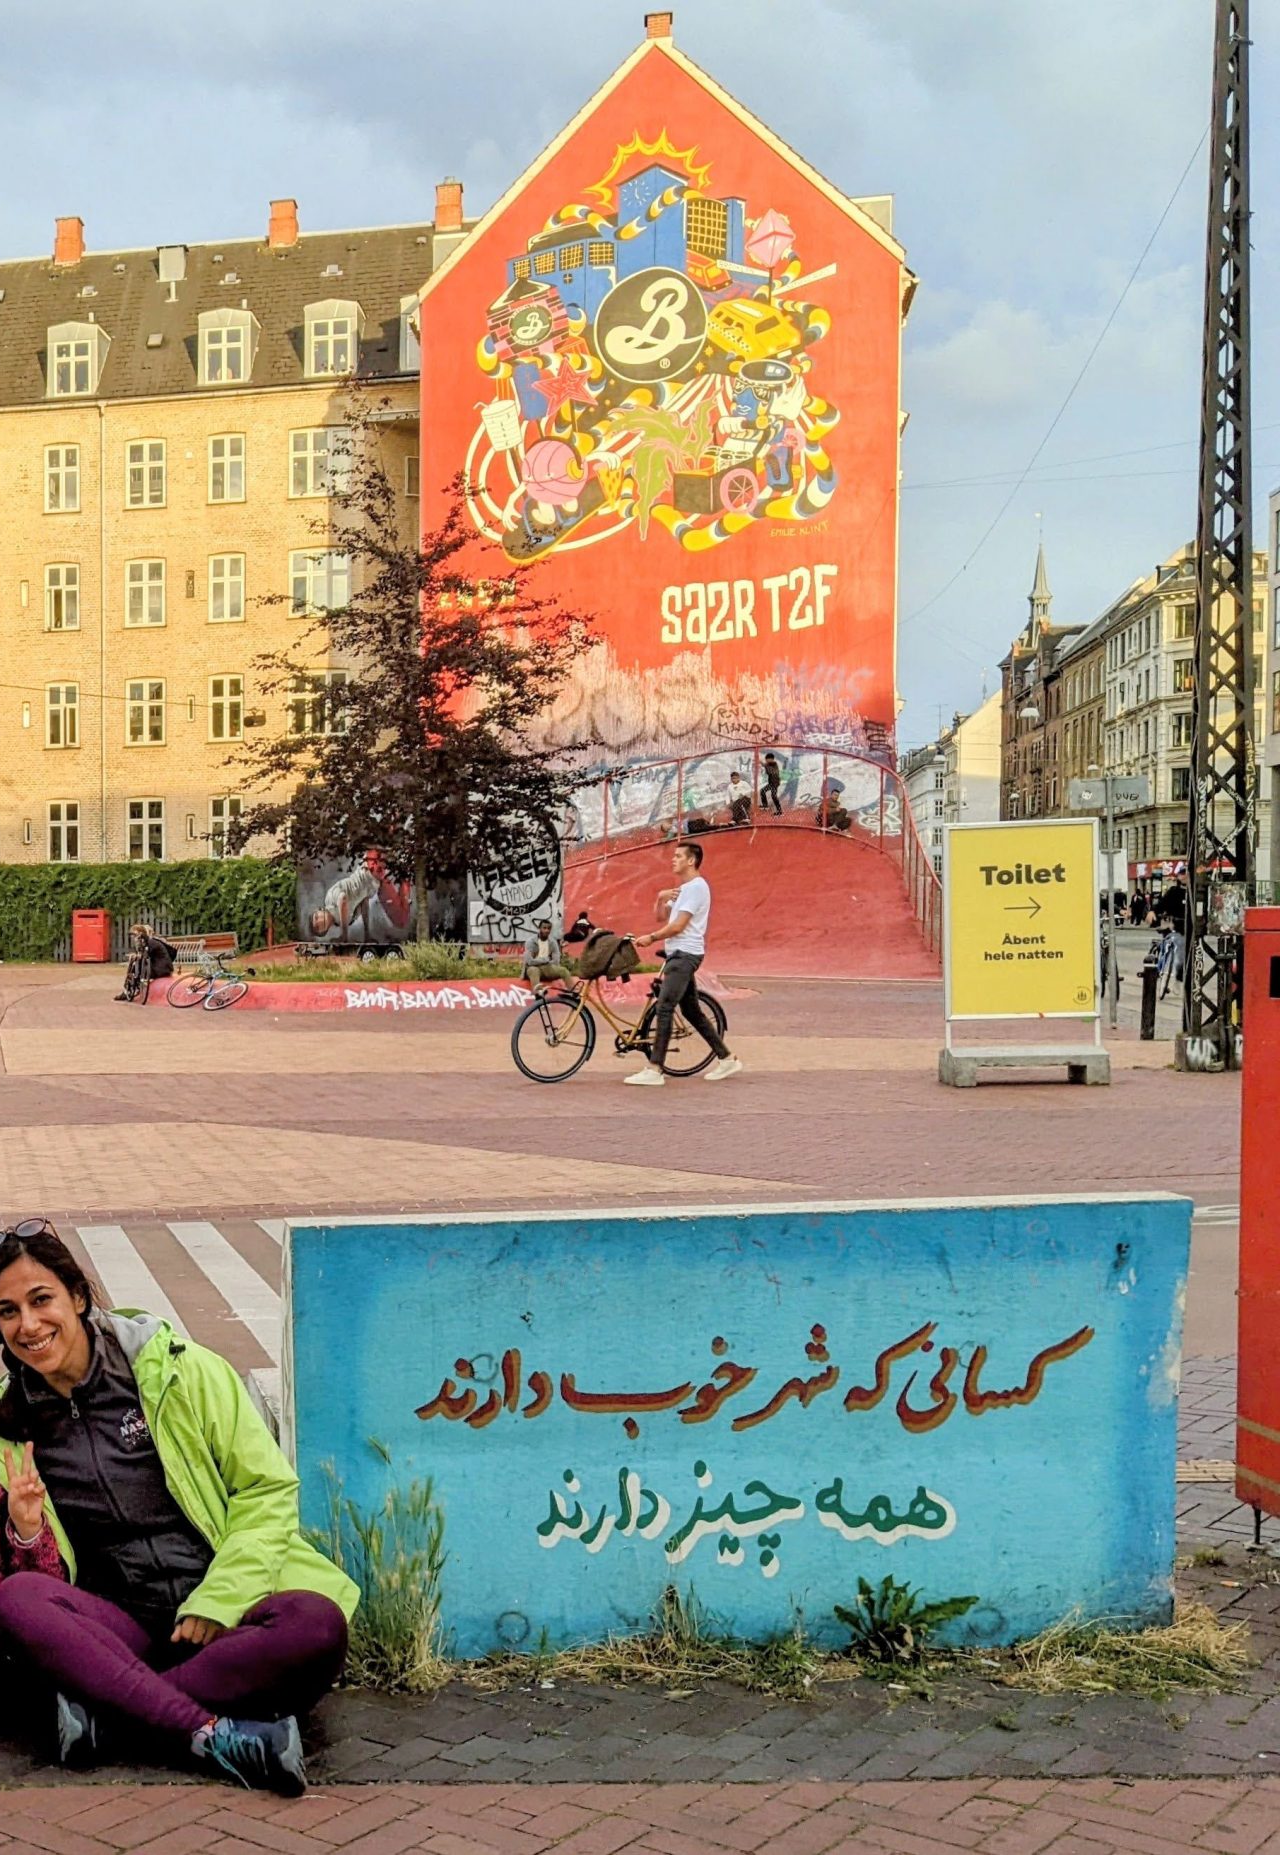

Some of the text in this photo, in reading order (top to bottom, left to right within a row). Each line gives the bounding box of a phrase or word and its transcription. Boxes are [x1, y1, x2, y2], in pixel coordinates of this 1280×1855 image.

[979, 863, 1066, 886] Toilet
[500, 884, 533, 904] HYPNO
[1002, 933, 1046, 945] Åbent
[984, 950, 1064, 961] hele natten
[415, 1321, 1095, 1440] کسانی که شهر خوب دارند
[536, 1460, 957, 1578] همه چیز دارند
